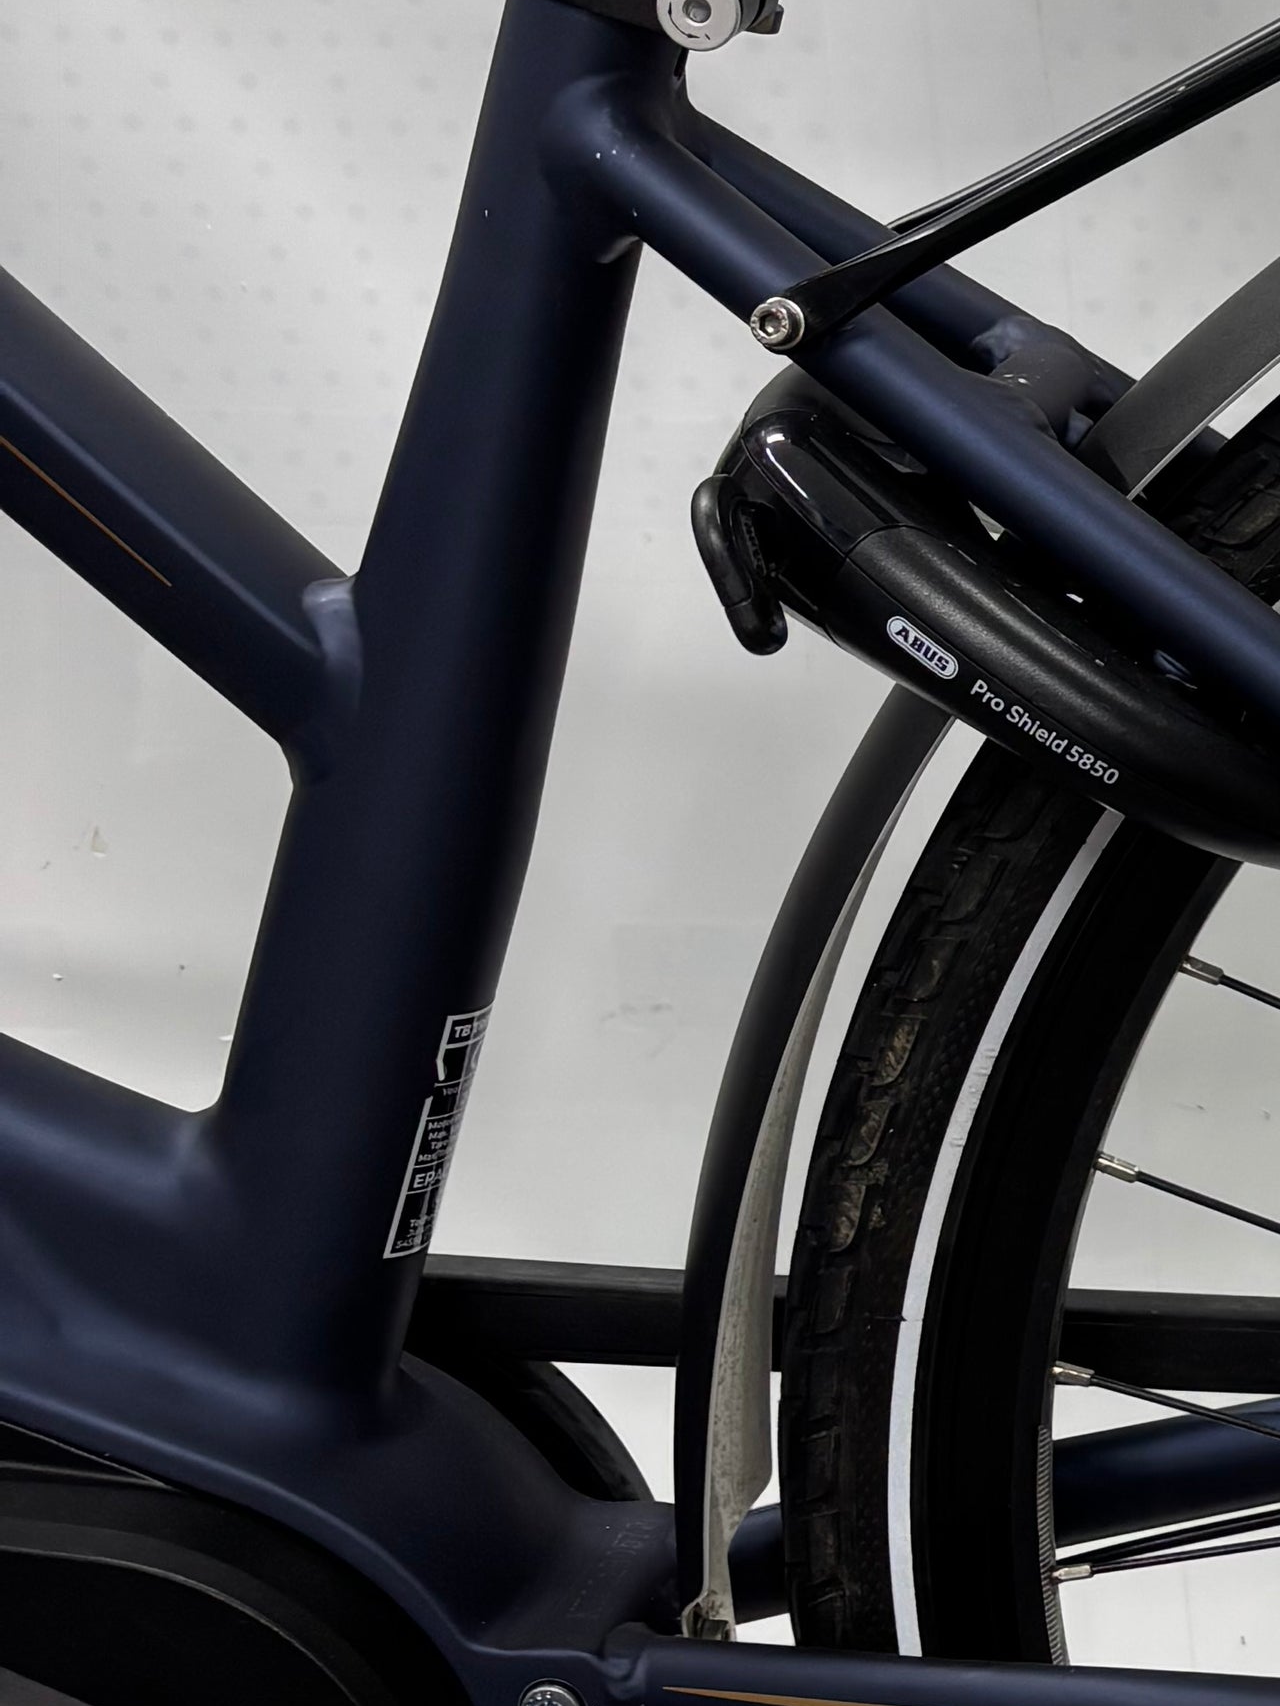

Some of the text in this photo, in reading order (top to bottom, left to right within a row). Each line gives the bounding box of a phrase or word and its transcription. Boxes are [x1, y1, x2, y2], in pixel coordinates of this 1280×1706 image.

[893, 623, 1119, 784] ABUS Pro Shield 5850
